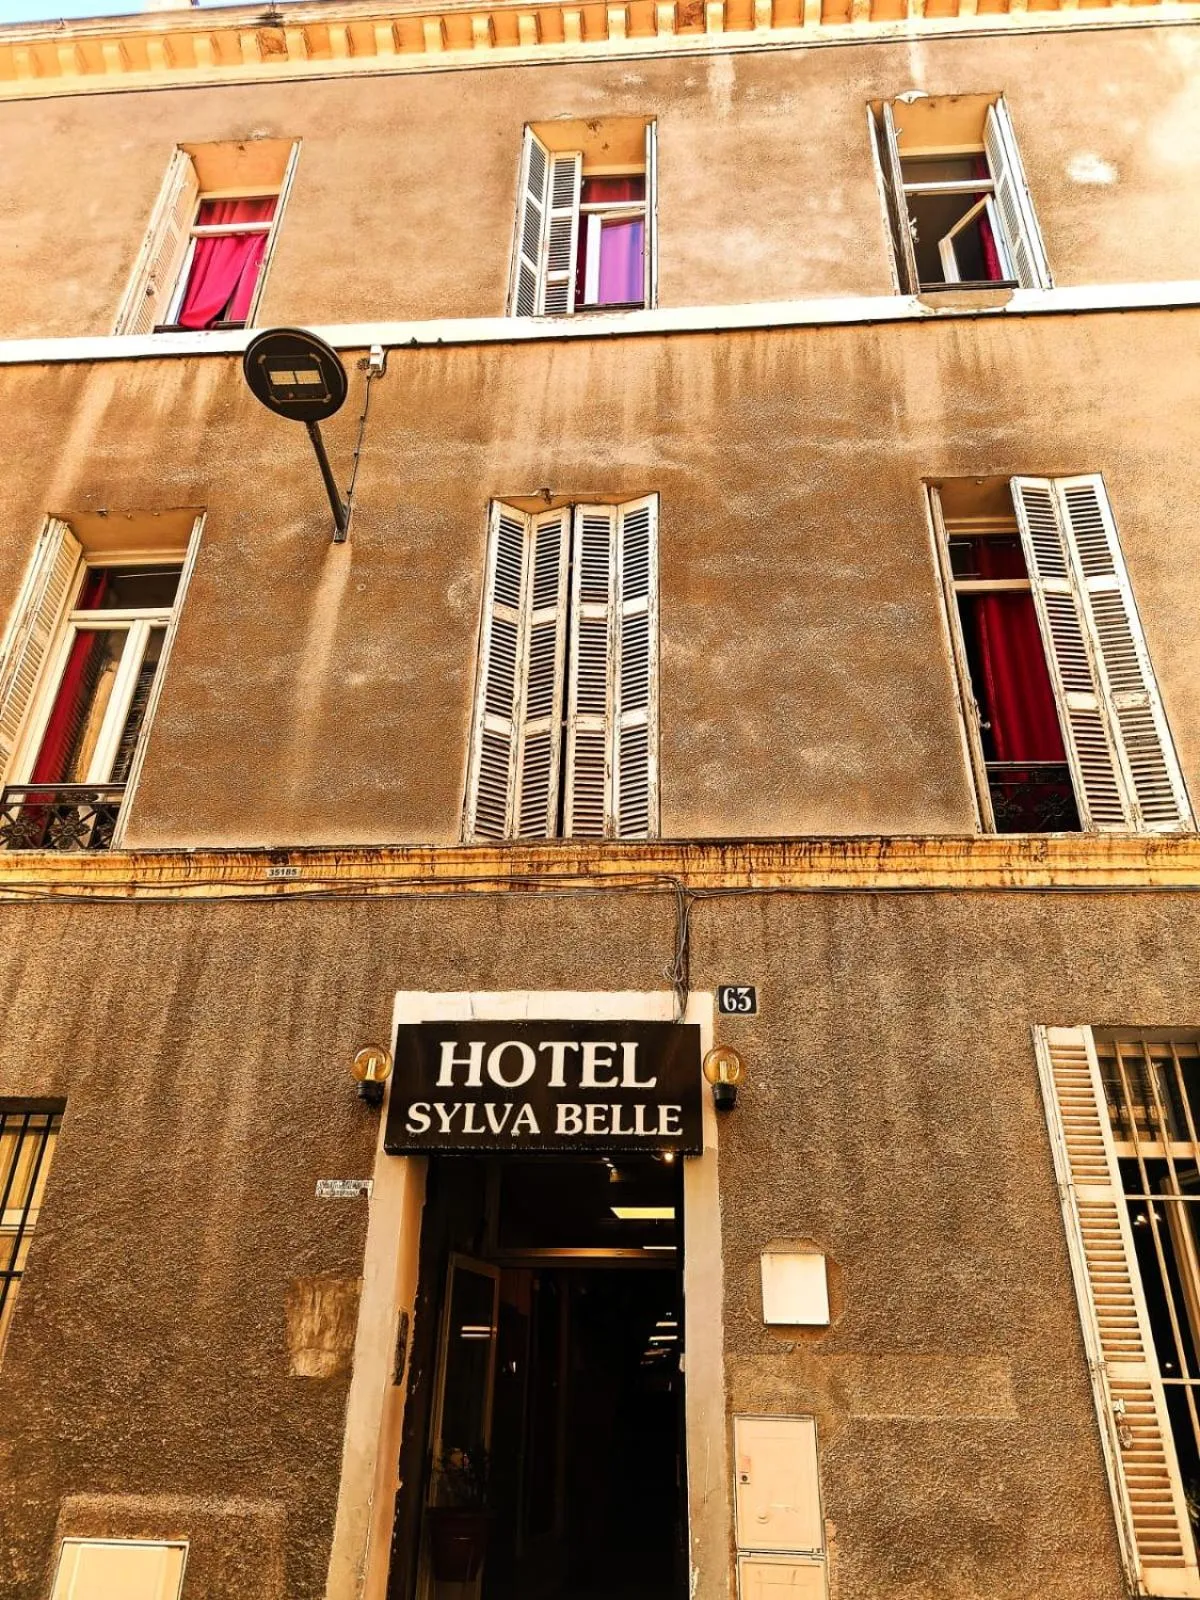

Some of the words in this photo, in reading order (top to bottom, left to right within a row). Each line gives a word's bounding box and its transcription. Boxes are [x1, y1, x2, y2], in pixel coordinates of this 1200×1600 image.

[723, 987, 752, 1012] 63
[435, 1040, 657, 1089] HOTEL
[404, 1101, 541, 1136] SYLVA
[554, 1103, 684, 1137] BELLE
